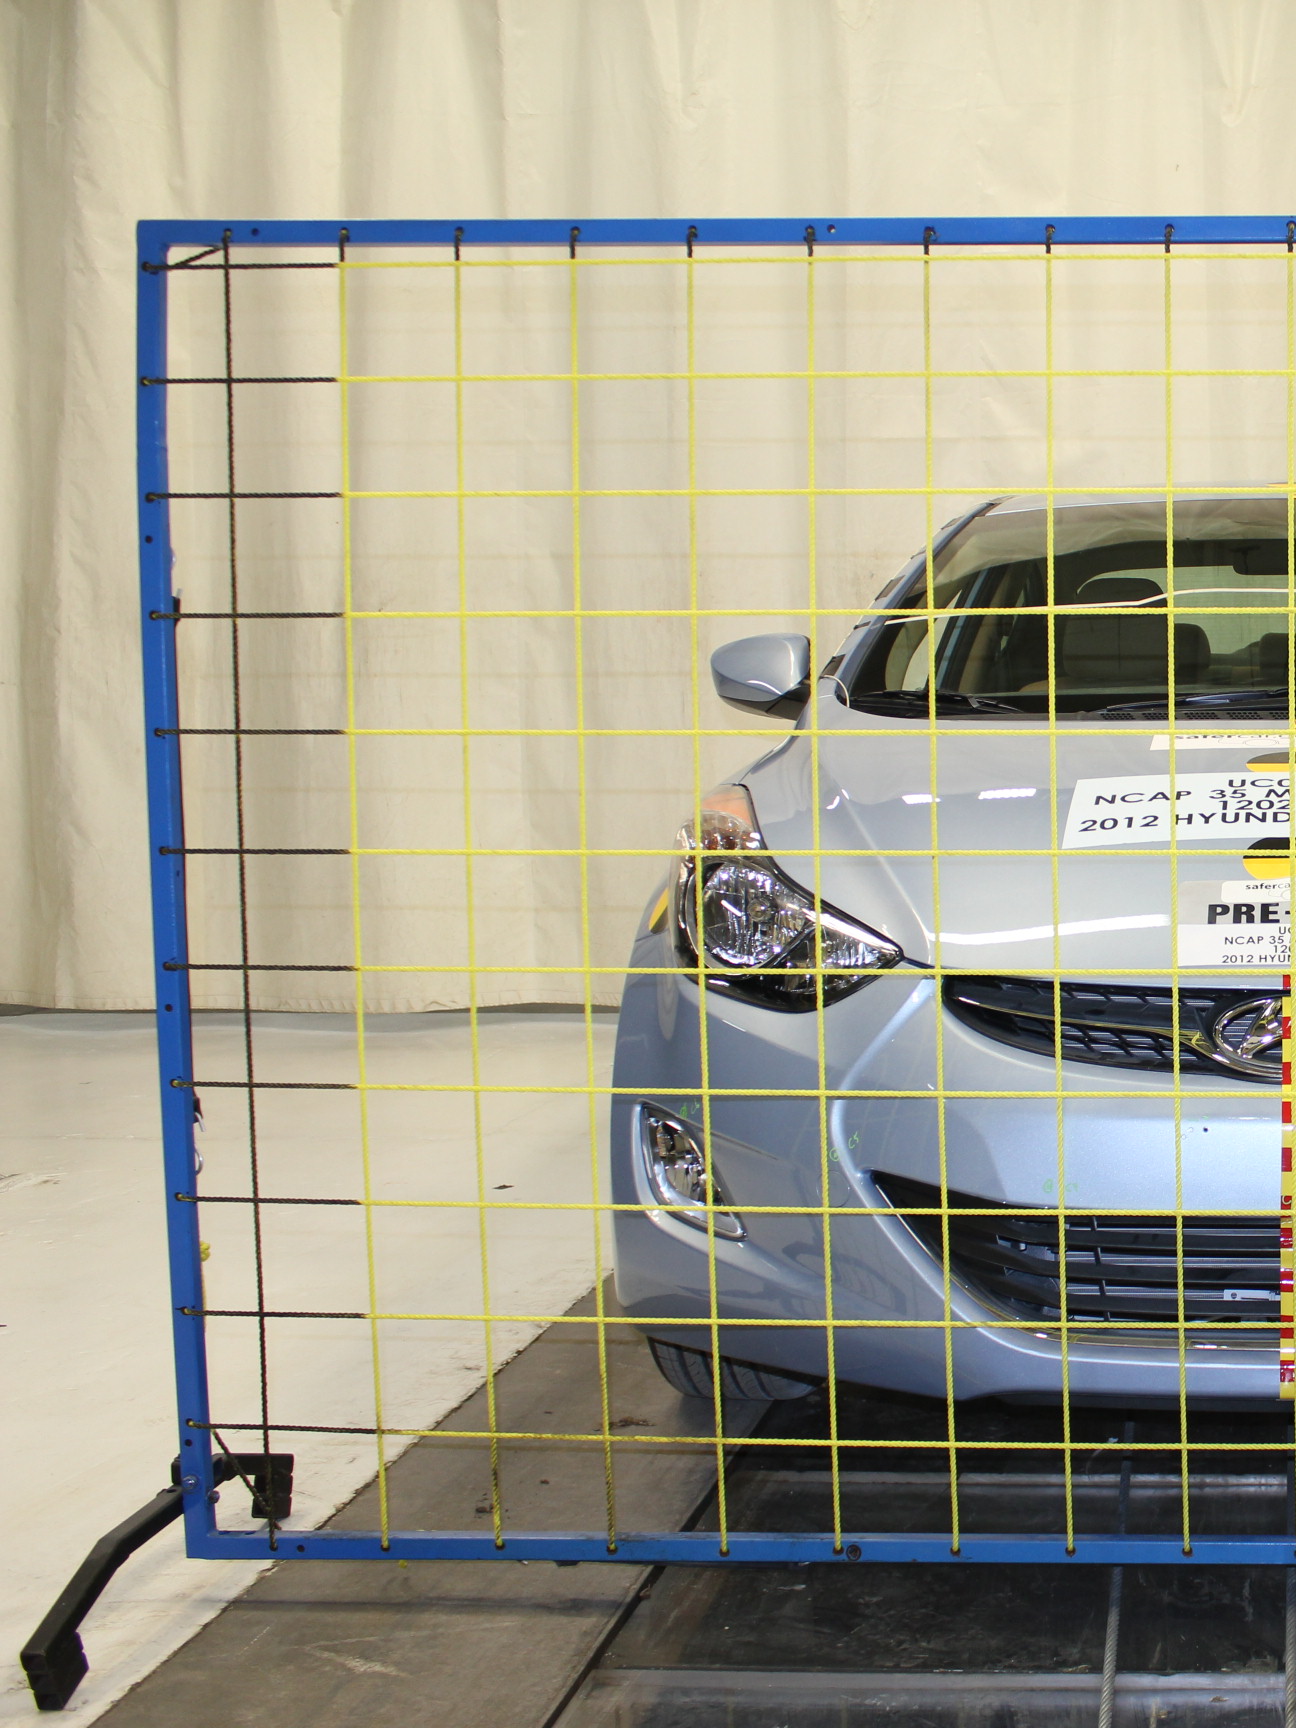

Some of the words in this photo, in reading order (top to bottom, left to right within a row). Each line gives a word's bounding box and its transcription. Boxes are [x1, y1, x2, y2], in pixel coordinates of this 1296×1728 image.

[1094, 790, 1192, 806] NCAP
[1209, 788, 1247, 799] 35
[1078, 815, 1159, 832] 2012
[1224, 935, 1264, 945] NCAP
[1268, 935, 1284, 945] 35
[1222, 955, 1254, 964] 2012
